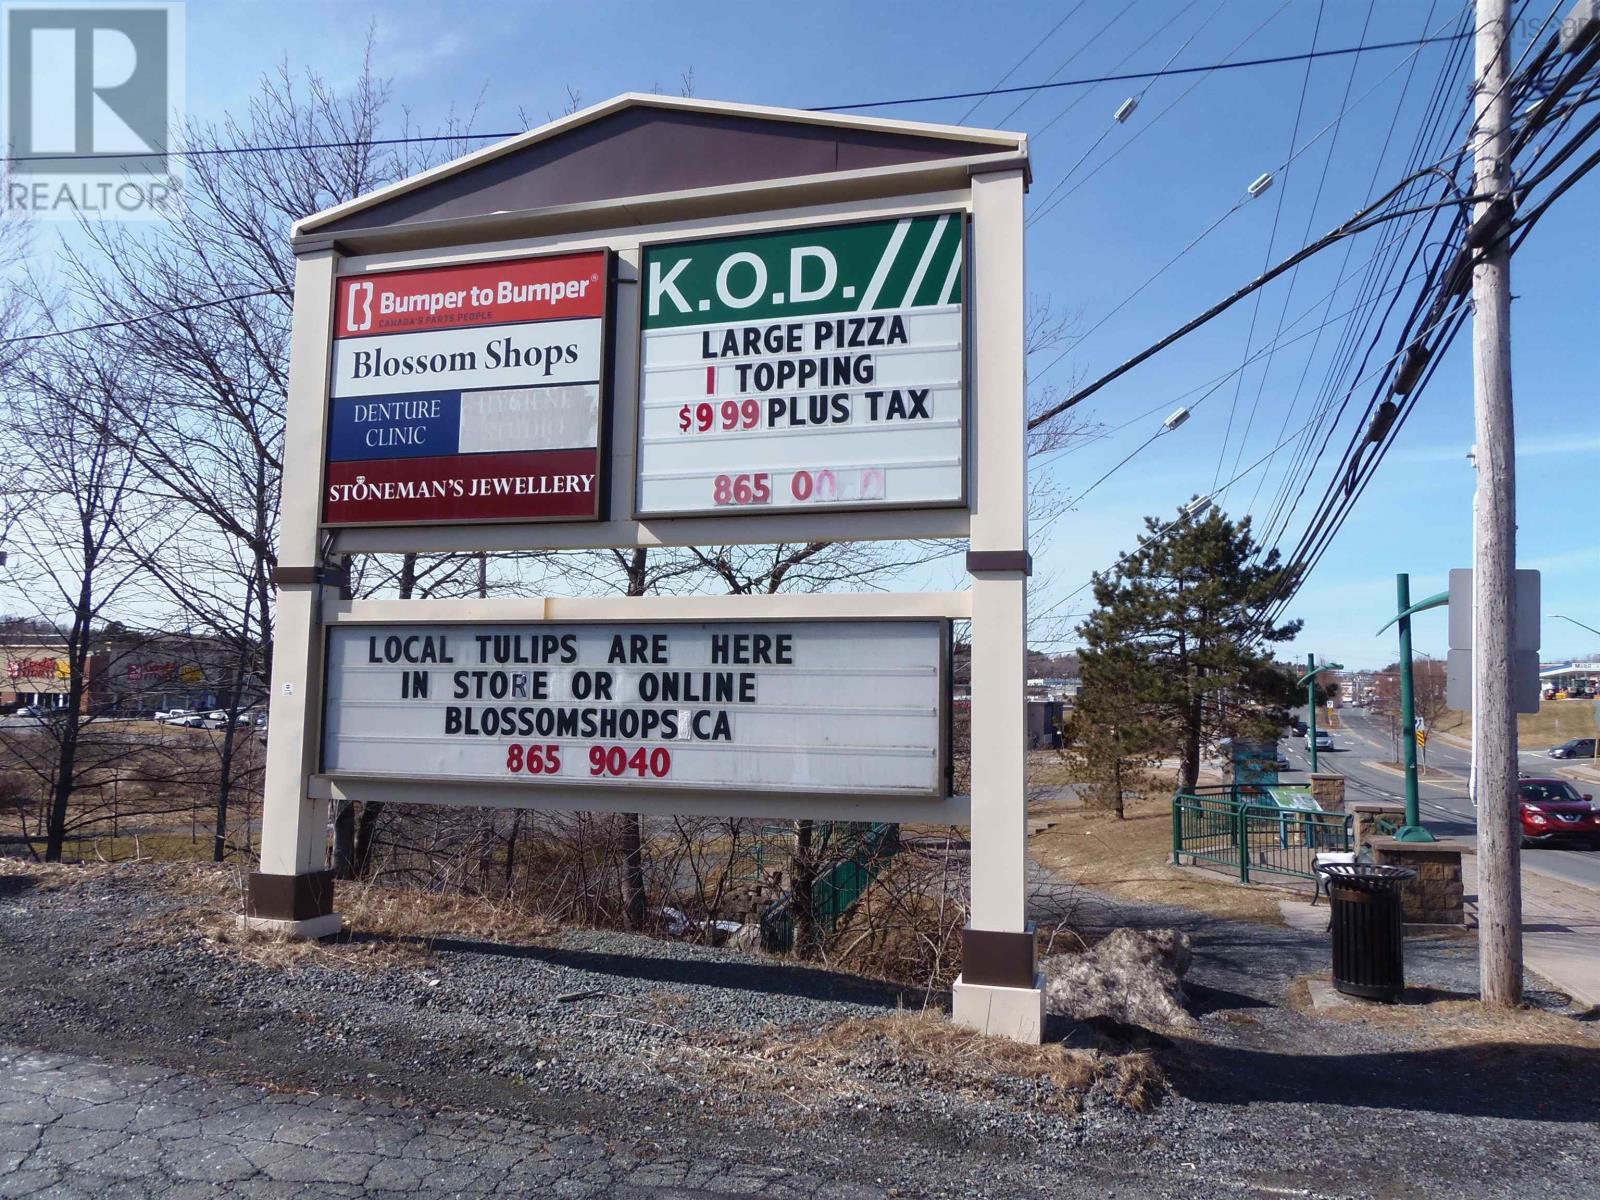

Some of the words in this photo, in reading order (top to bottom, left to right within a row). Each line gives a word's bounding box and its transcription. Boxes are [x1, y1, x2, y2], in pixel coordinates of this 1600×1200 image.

[648, 245, 855, 316] K.O.D.
[380, 288, 466, 314] Bumper
[470, 287, 493, 307] to
[378, 316, 424, 328] CANADA'S
[425, 314, 454, 324] PARTS
[457, 311, 493, 321] PEOPLE
[702, 323, 804, 359] LARGE
[814, 315, 908, 349] PIZZA
[352, 347, 477, 379] Blossom
[484, 337, 578, 377] Shops
[735, 354, 874, 392] TOPPING
[354, 400, 441, 423] DENTURE
[865, 388, 930, 420] TAX
[366, 426, 427, 447] CLINIC
[329, 477, 464, 502] STONEMAN'S
[468, 474, 595, 496] JEWELLERY
[713, 473, 770, 505] 865
[369, 635, 453, 664] LOCAL
[475, 634, 577, 664] TULIPS
[608, 634, 668, 664] ARE
[711, 634, 793, 665] HERE
[401, 671, 428, 699] IN
[453, 671, 547, 699] STORE
[571, 671, 612, 700] OR
[639, 672, 756, 703] ONLINE
[507, 744, 561, 774] 865
[589, 746, 671, 778] 9040
